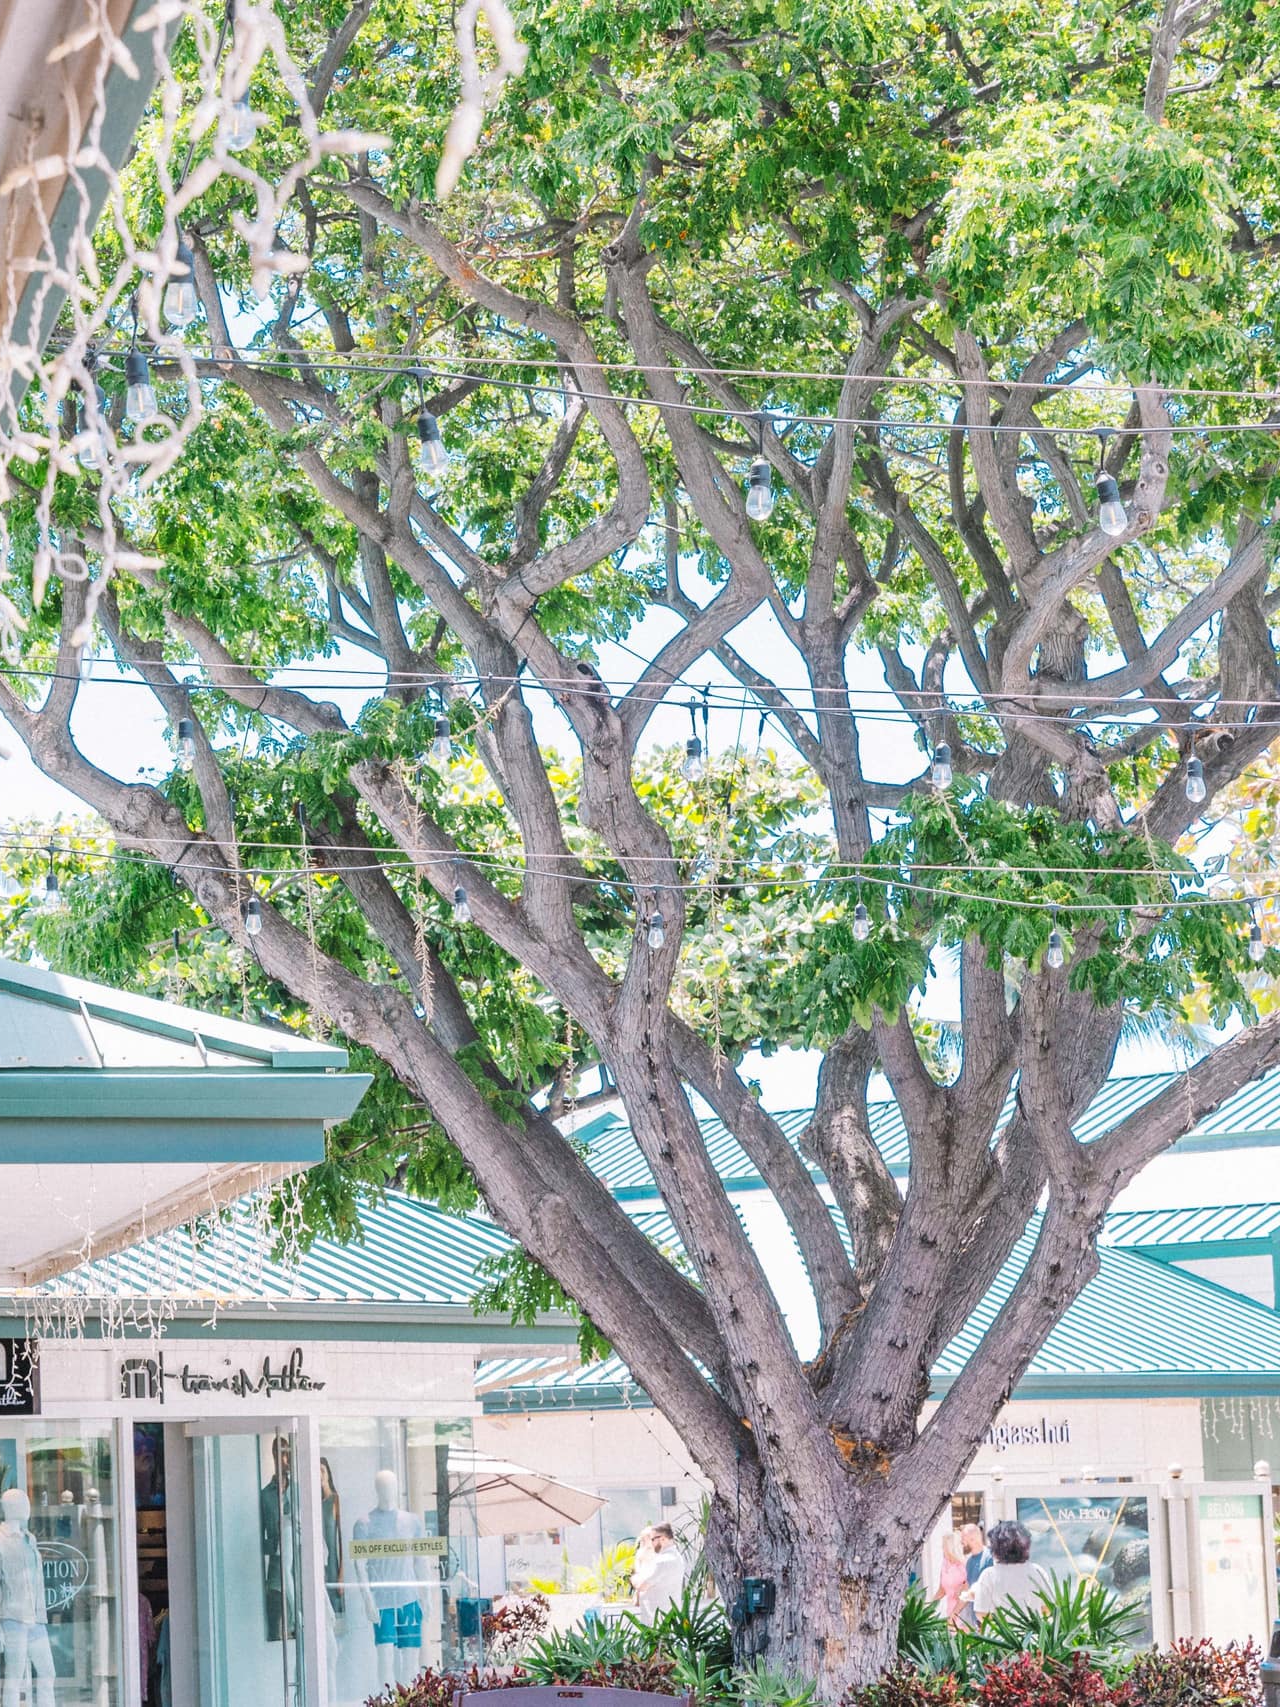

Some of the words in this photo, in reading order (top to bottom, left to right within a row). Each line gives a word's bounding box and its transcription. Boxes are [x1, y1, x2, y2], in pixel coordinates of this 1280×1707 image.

[353, 1545, 368, 1554] 30%
[368, 1544, 382, 1553] OFF
[419, 1541, 444, 1552] STYLES
